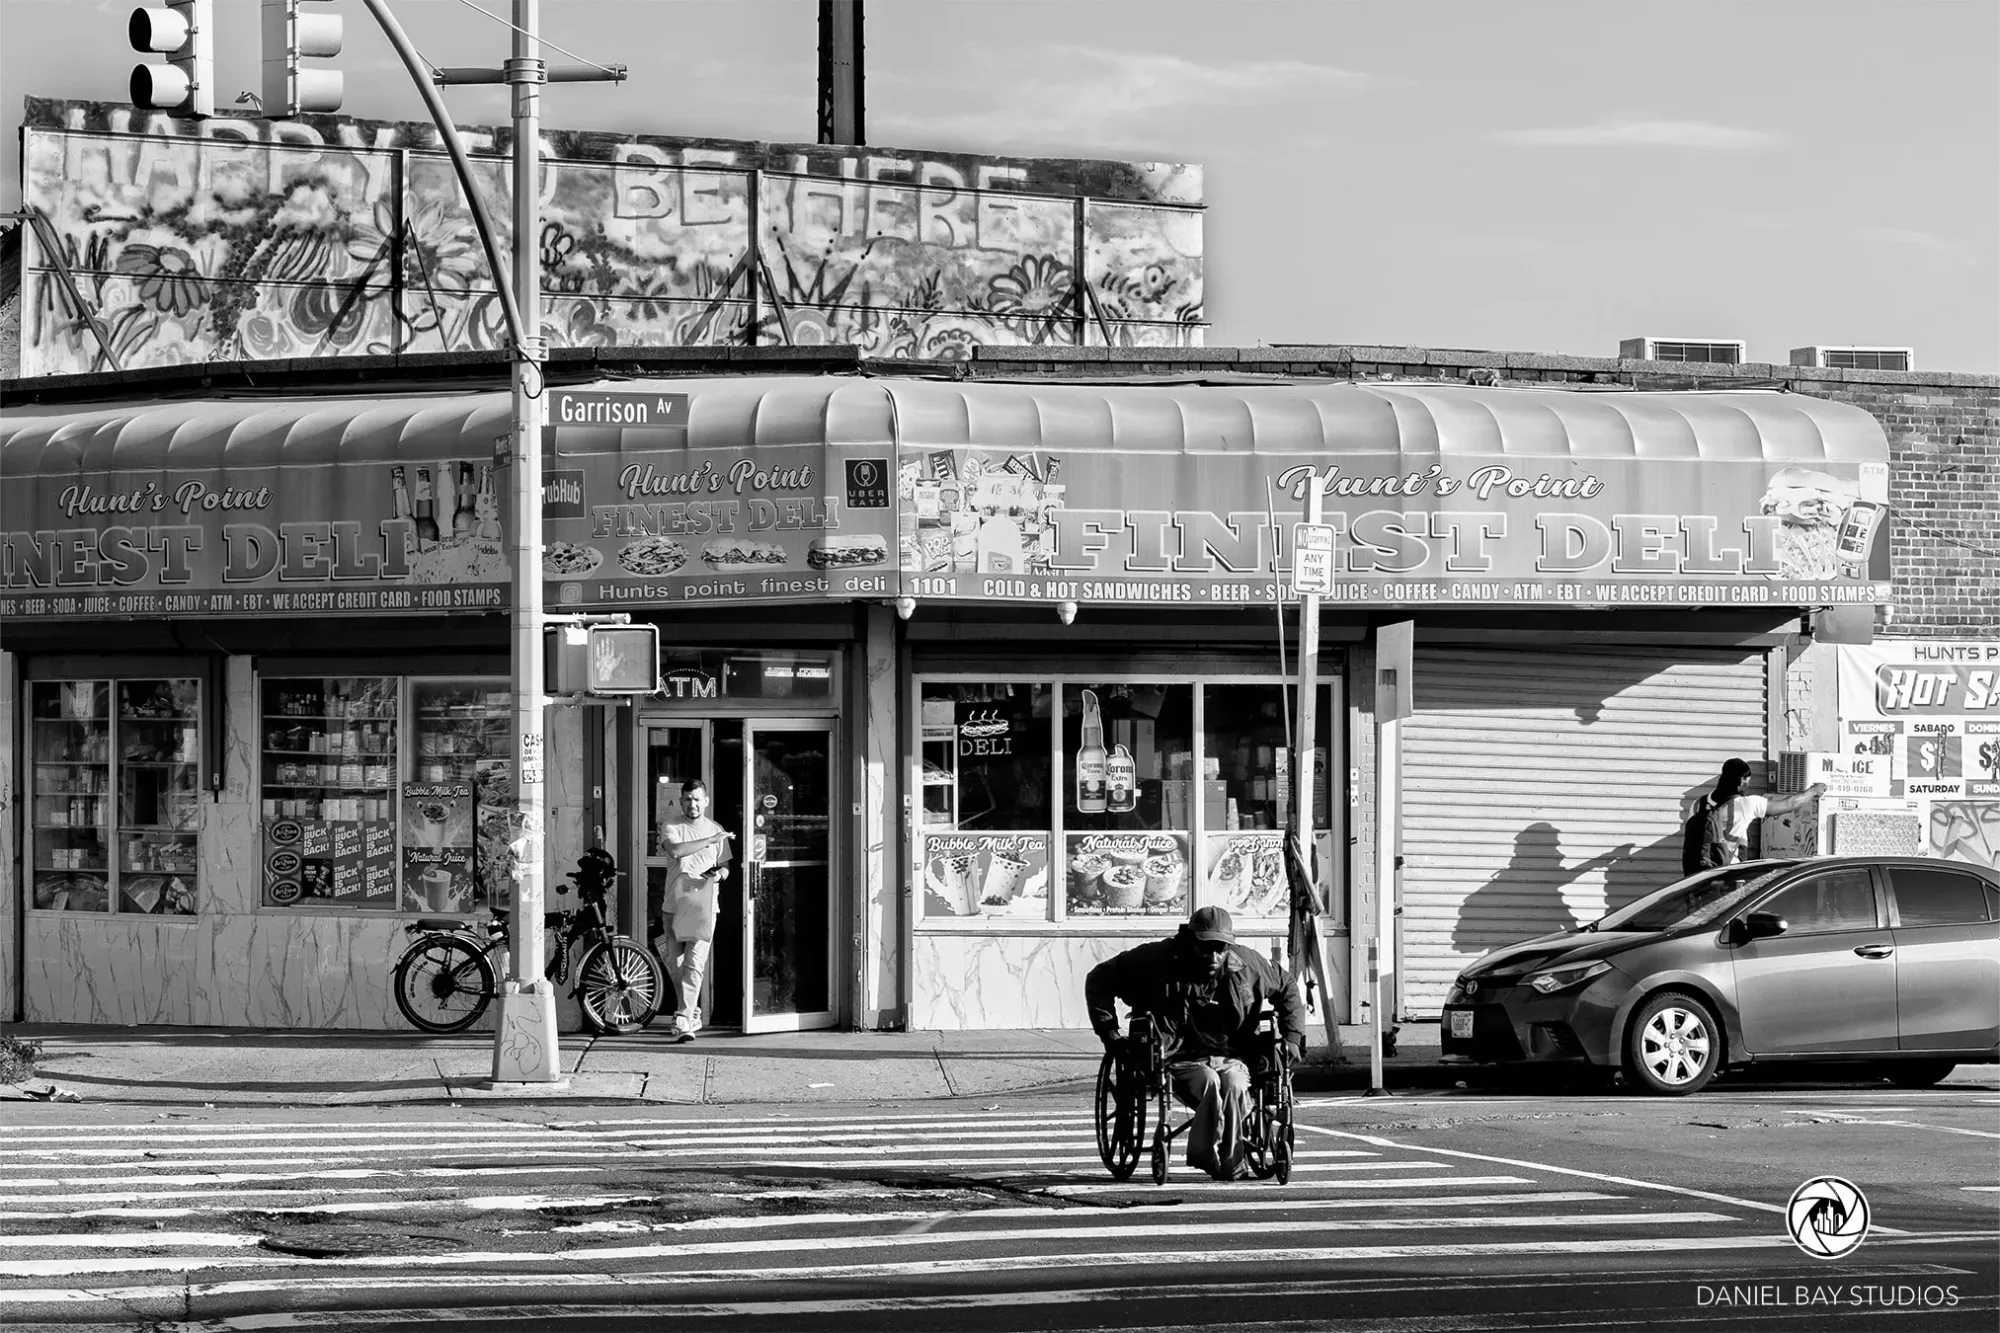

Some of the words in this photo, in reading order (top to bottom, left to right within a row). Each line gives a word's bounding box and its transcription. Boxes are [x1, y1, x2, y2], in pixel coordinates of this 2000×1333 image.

[612, 143, 736, 226] BE
[787, 152, 1028, 255] HERE
[561, 395, 647, 423] Garrison
[656, 398, 672, 415] Av
[619, 460, 724, 498] Hunt's
[728, 458, 816, 496] Point
[1862, 466, 1885, 475] ATM
[1276, 463, 1461, 501] Hunt's
[1467, 463, 1606, 500] Point
[59, 480, 170, 517] Hunt's
[174, 479, 275, 515] Point
[541, 478, 581, 505] rubHub
[848, 489, 885, 497] UBER
[592, 499, 740, 538] FINEST
[747, 495, 841, 533] DELI
[1297, 528, 1308, 547] NO
[1534, 511, 1783, 576] DELI
[0, 523, 204, 590] NEST
[222, 519, 416, 586] DELI
[1304, 553, 1324, 563] ANY
[1303, 566, 1324, 577] TIME
[910, 577, 958, 595] 1101
[983, 579, 1026, 597] COLD
[1029, 583, 1042, 598] &
[1046, 581, 1079, 599] HOT
[1082, 582, 1192, 601] SANDWICHES
[1211, 583, 1251, 601] BEER
[1265, 583, 1302, 601] SOD
[1383, 583, 1438, 600] COFFEE
[1451, 583, 1500, 600] CANDY
[1513, 584, 1543, 600] ATM
[1556, 584, 1582, 601] EBT
[1595, 584, 1618, 601] WE
[1620, 584, 1675, 601] ACCEPT
[1678, 585, 1728, 602] CREDIT
[1731, 585, 1769, 602] CARD
[1782, 585, 1817, 602] FOOD
[1820, 585, 1876, 602] STAMPS
[25, 598, 46, 614] BEER
[52, 598, 76, 614] SODA
[83, 596, 110, 613] JUICE
[118, 595, 156, 613] COFFEE
[165, 594, 201, 612] CANDY
[210, 594, 233, 611] ATM
[242, 593, 263, 611] EBT
[272, 593, 290, 610] WE
[292, 592, 335, 610] ACCEPT
[337, 591, 378, 609] CREDIT
[380, 590, 411, 608] CARD
[421, 589, 451, 607] FOOD
[454, 588, 501, 606] STAMPS
[1914, 646, 1980, 660] HUNTS
[1884, 668, 1958, 710] HOT
[1852, 722, 1896, 733] VIERNES
[1913, 723, 1955, 733] SABADO
[960, 737, 1012, 757] DELI
[1852, 759, 1874, 775] ICE
[404, 785, 431, 797] Bubble
[431, 785, 452, 798] Milk
[453, 785, 470, 798] Tea
[1909, 784, 1960, 794] SATURDAY
[304, 827, 327, 840] BUCK
[335, 828, 358, 842] BUCK
[366, 828, 390, 842] BUCK
[304, 839, 312, 848] IS
[304, 843, 330, 856] BACK!
[335, 840, 344, 850] IS
[335, 843, 361, 858] BACK!
[366, 840, 375, 850] IS
[366, 843, 393, 858] BACK!
[927, 836, 976, 852] Bubble
[978, 836, 1016, 853] Milk
[1017, 836, 1046, 853] Tea
[1081, 835, 1137, 851] Natural
[1134, 835, 1175, 855] Juice
[410, 851, 442, 863] Natural
[443, 851, 467, 866] Juice
[335, 867, 358, 881] BUCK
[366, 867, 390, 881] BUCK
[335, 879, 344, 889] IS
[335, 882, 361, 897] BACK!
[366, 879, 375, 889] IS
[366, 882, 393, 898] BACK!
